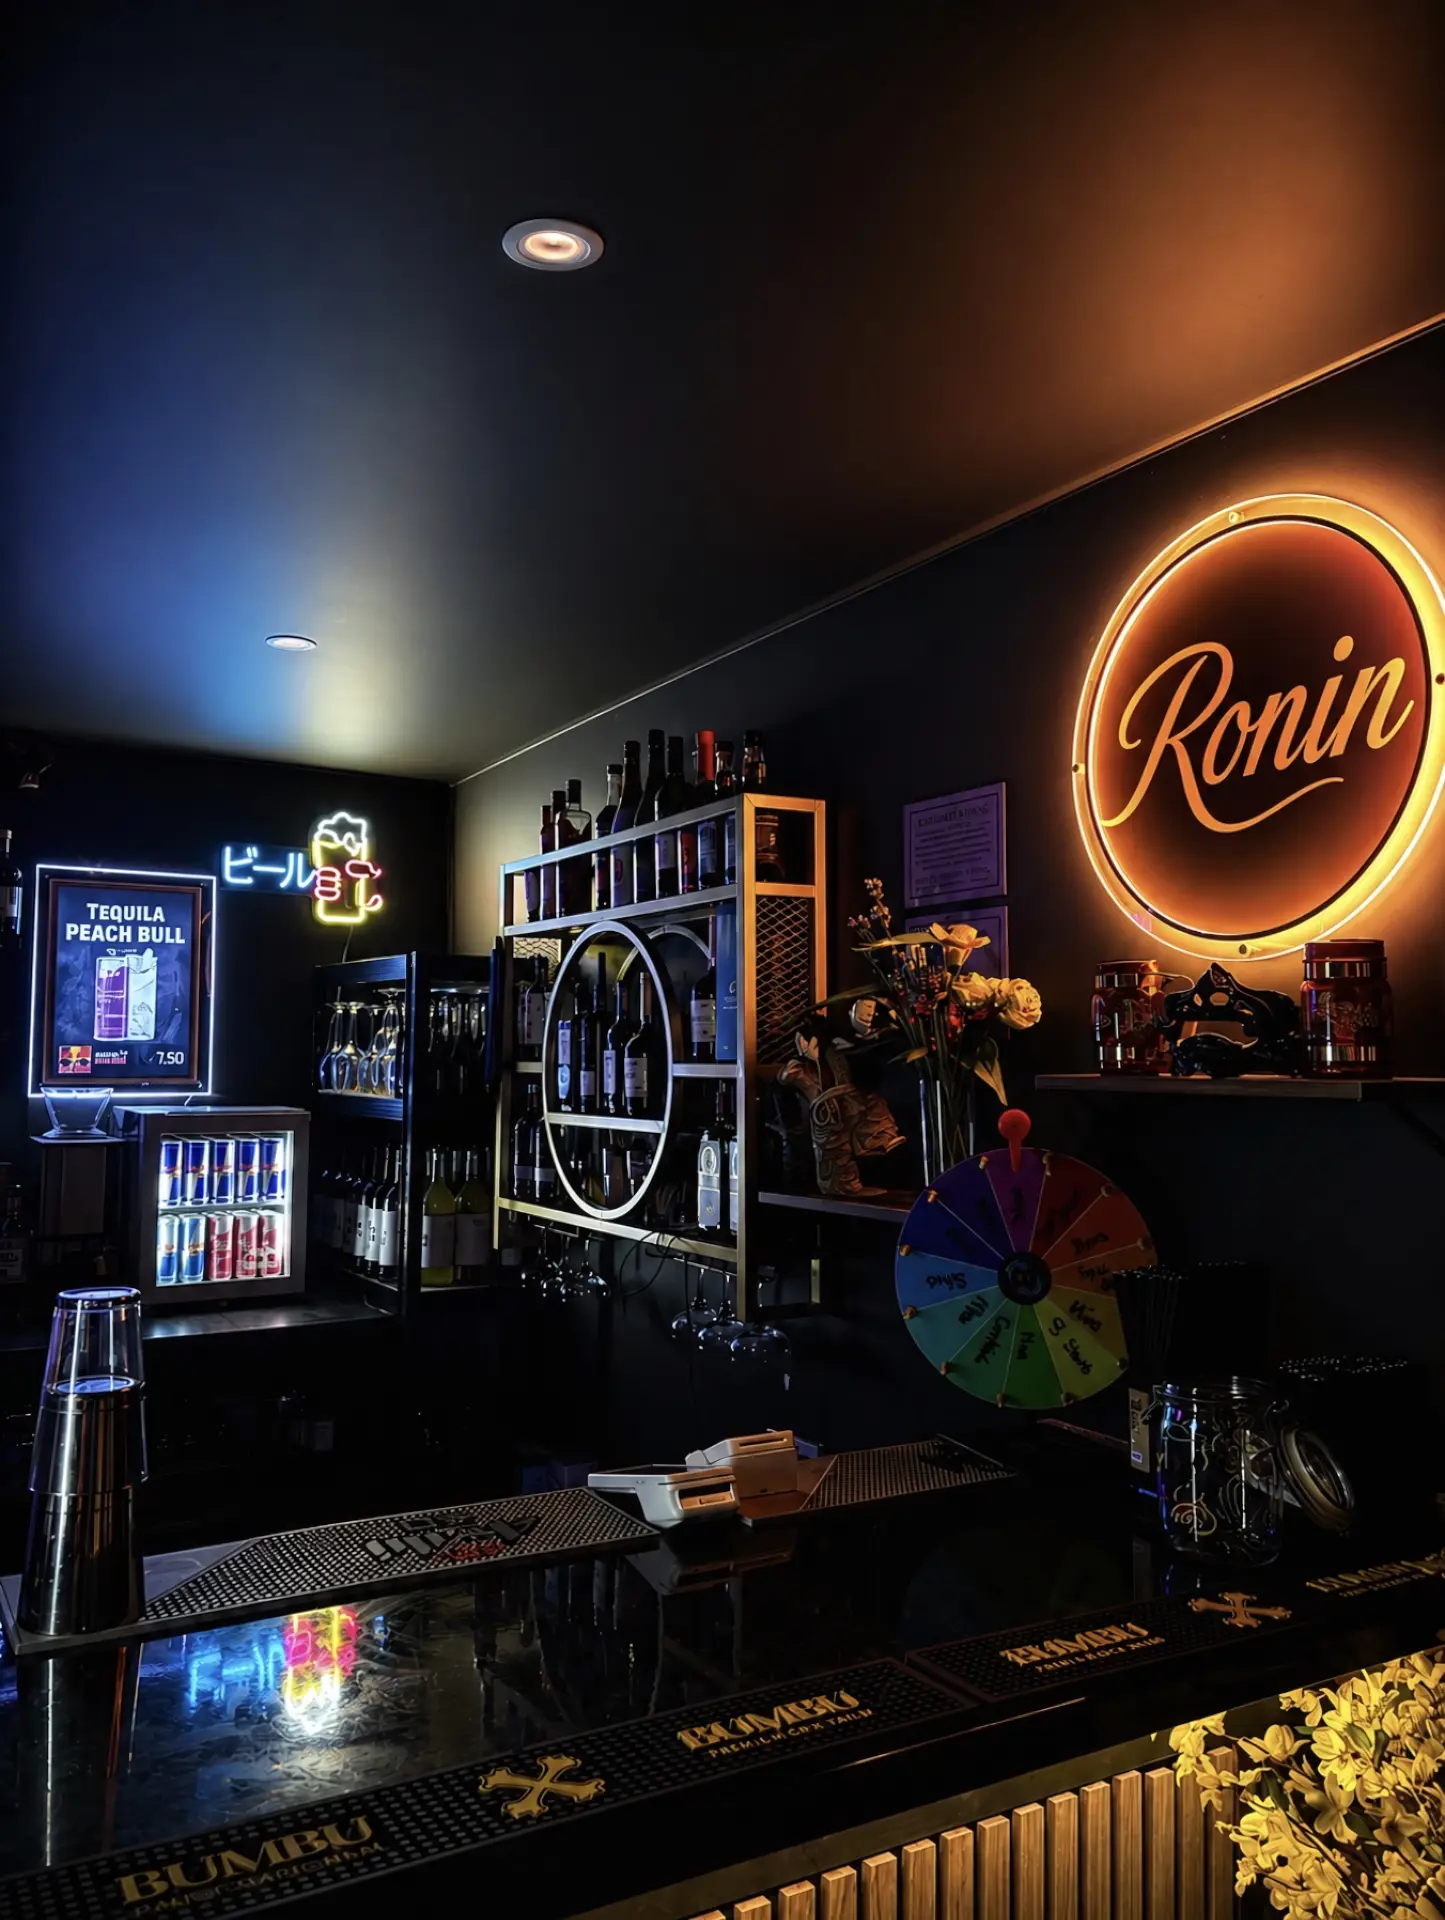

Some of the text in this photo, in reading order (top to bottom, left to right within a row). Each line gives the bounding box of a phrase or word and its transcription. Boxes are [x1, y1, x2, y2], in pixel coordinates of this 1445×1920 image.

[1102, 635, 1415, 834] Ronin
[222, 845, 316, 888] ビール
[86, 902, 165, 923] TEQUILA
[65, 923, 186, 945] PEACH BULL
[156, 1051, 185, 1066] 7.50
[115, 1815, 373, 1906] BUMBU
